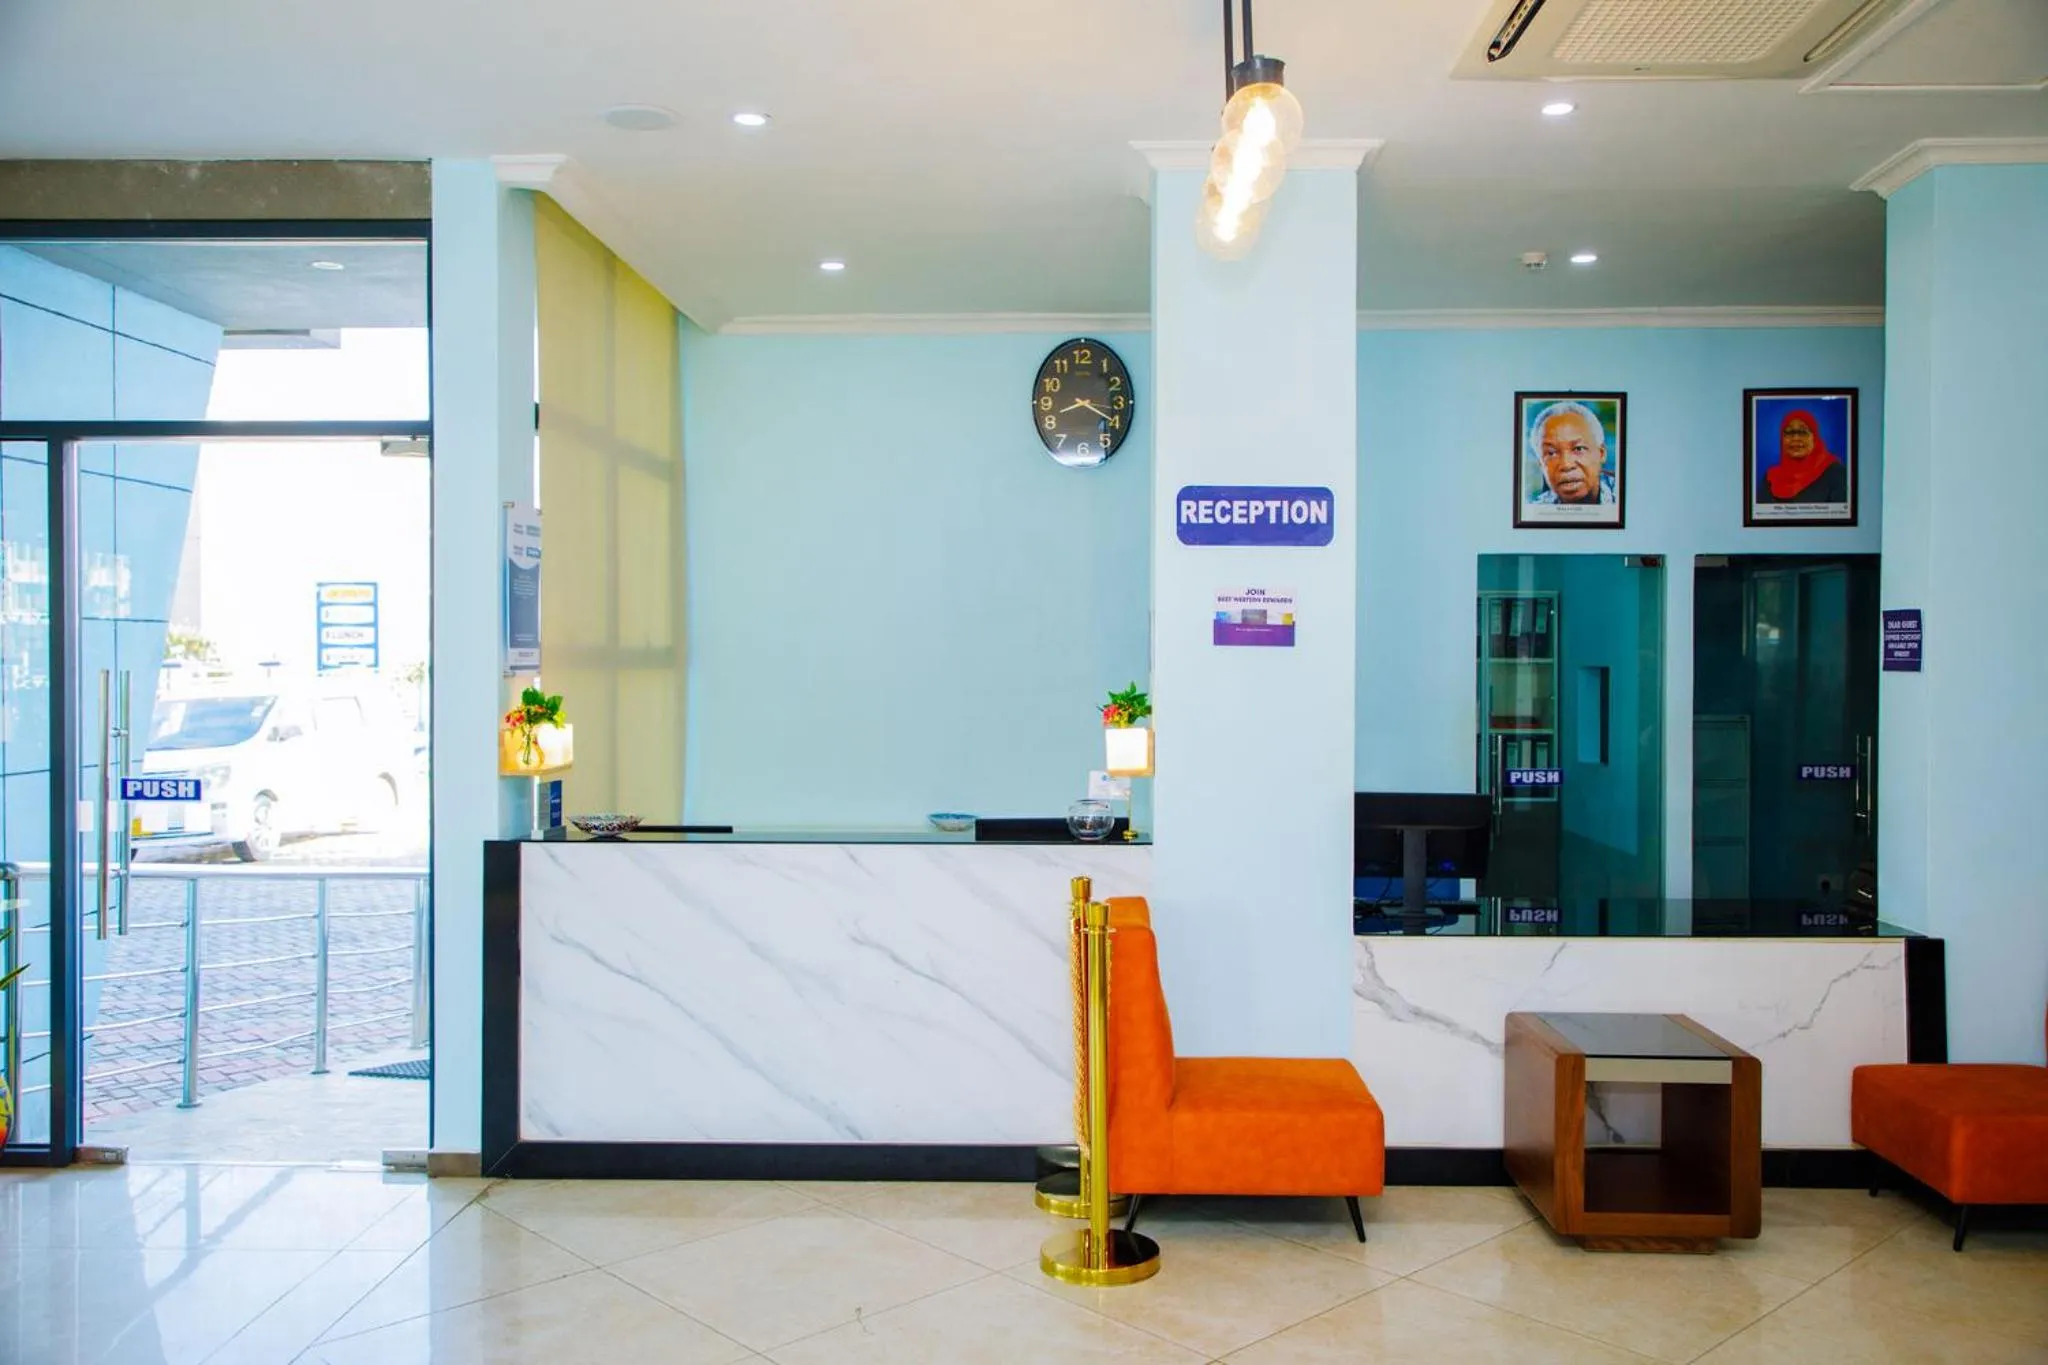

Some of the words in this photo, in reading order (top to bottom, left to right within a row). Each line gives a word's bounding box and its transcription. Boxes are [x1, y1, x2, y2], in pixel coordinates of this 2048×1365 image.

[1073, 349, 1092, 364] 12
[1054, 358, 1068, 373] 11
[1101, 358, 1108, 373] 1
[1043, 377, 1060, 393] 10
[1109, 376, 1121, 392] 2
[1041, 396, 1053, 411] 9
[1113, 395, 1125, 410] 3
[1044, 415, 1056, 430] 8
[1108, 415, 1120, 430] 4
[1055, 433, 1067, 449] 7
[1099, 433, 1111, 448] 5
[1076, 442, 1089, 457] 6
[1180, 500, 1328, 525] RECEPTION
[1245, 588, 1266, 596] JOIN
[1510, 771, 1560, 784] PUSH
[1802, 766, 1851, 779] PUSH
[126, 780, 195, 798] PUSH
